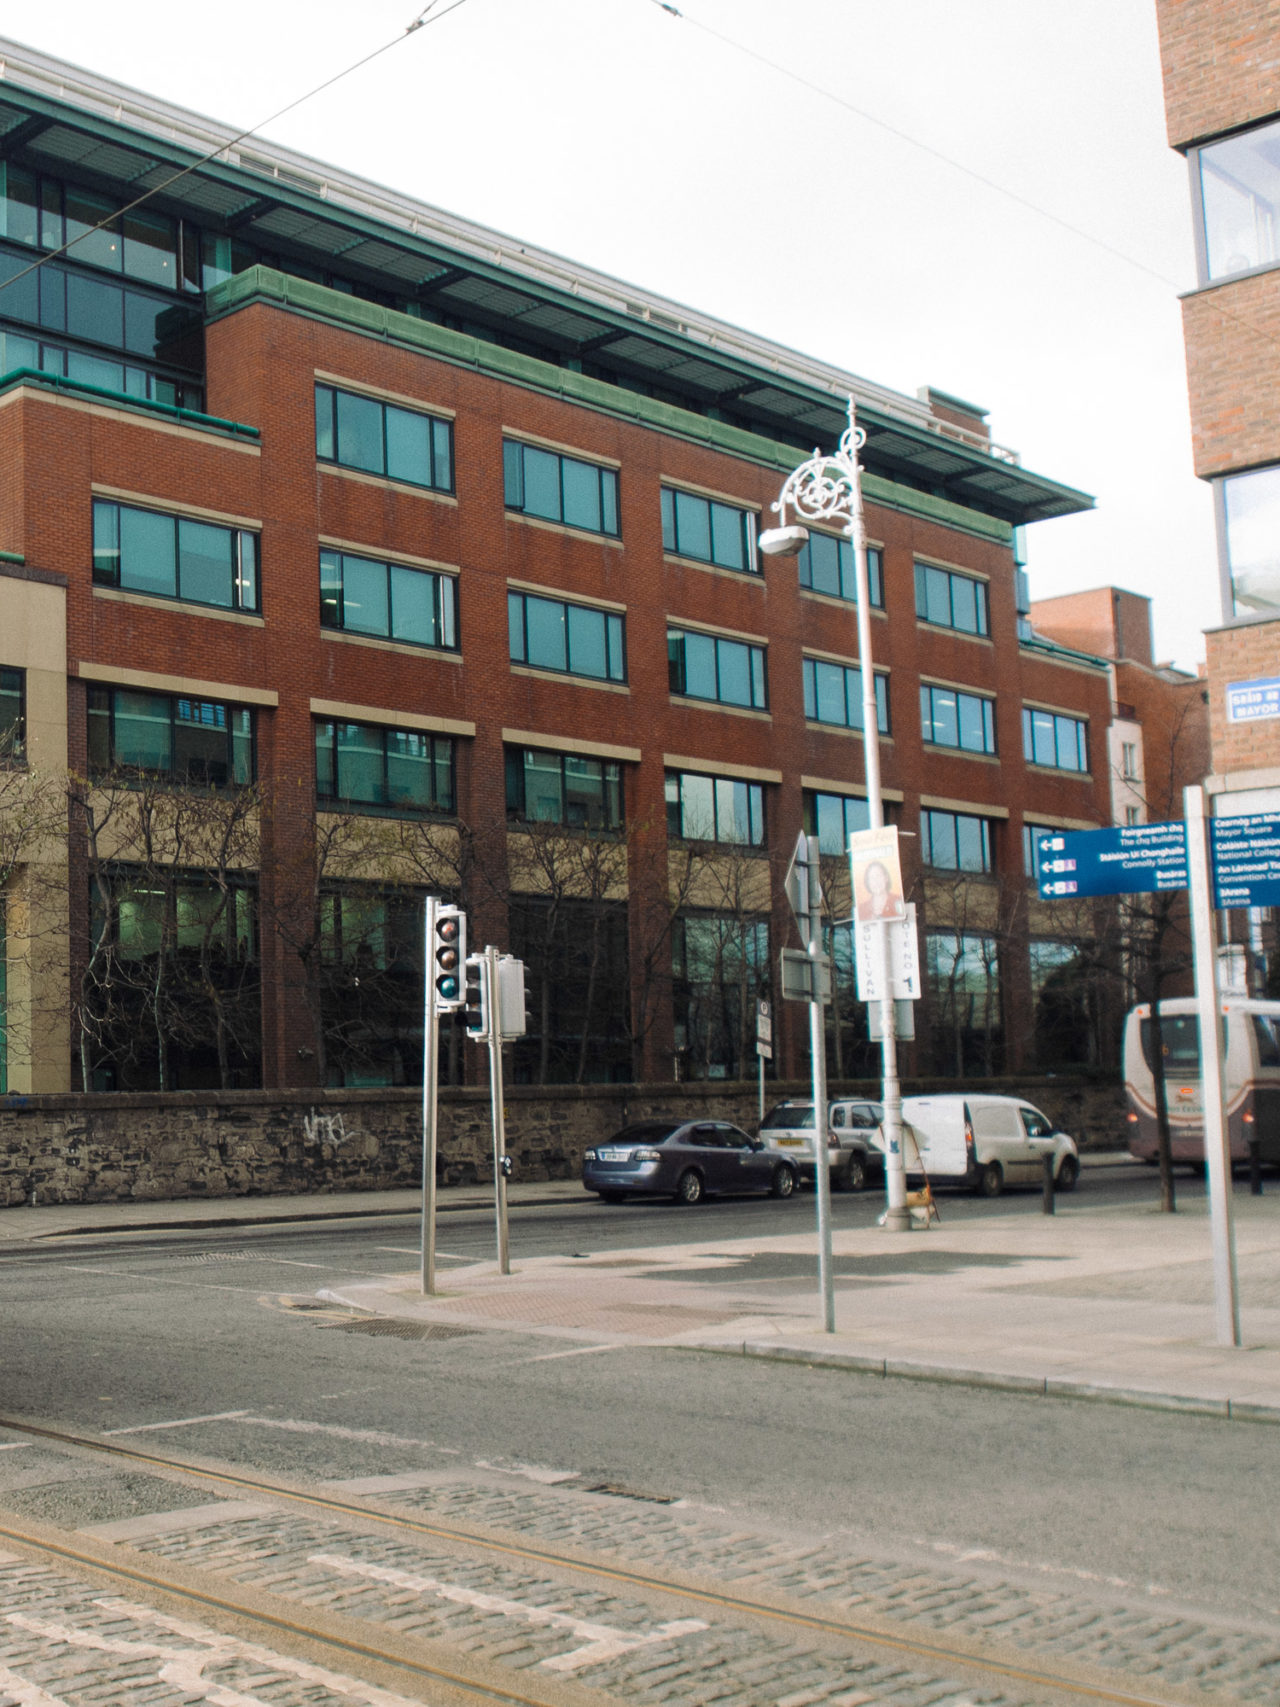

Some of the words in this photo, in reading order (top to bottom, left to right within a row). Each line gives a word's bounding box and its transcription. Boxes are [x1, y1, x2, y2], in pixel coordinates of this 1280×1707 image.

[1237, 703, 1279, 717] MAYOR
[1215, 828, 1242, 838] Mayor
[1243, 825, 1273, 835] Square
[1121, 838, 1135, 846] The
[1151, 834, 1184, 844] Building
[1217, 849, 1252, 860] National
[1122, 859, 1156, 869] Connolly
[1157, 857, 1186, 866] Station
[1218, 866, 1231, 874] An
[1219, 873, 1266, 884] Convention
